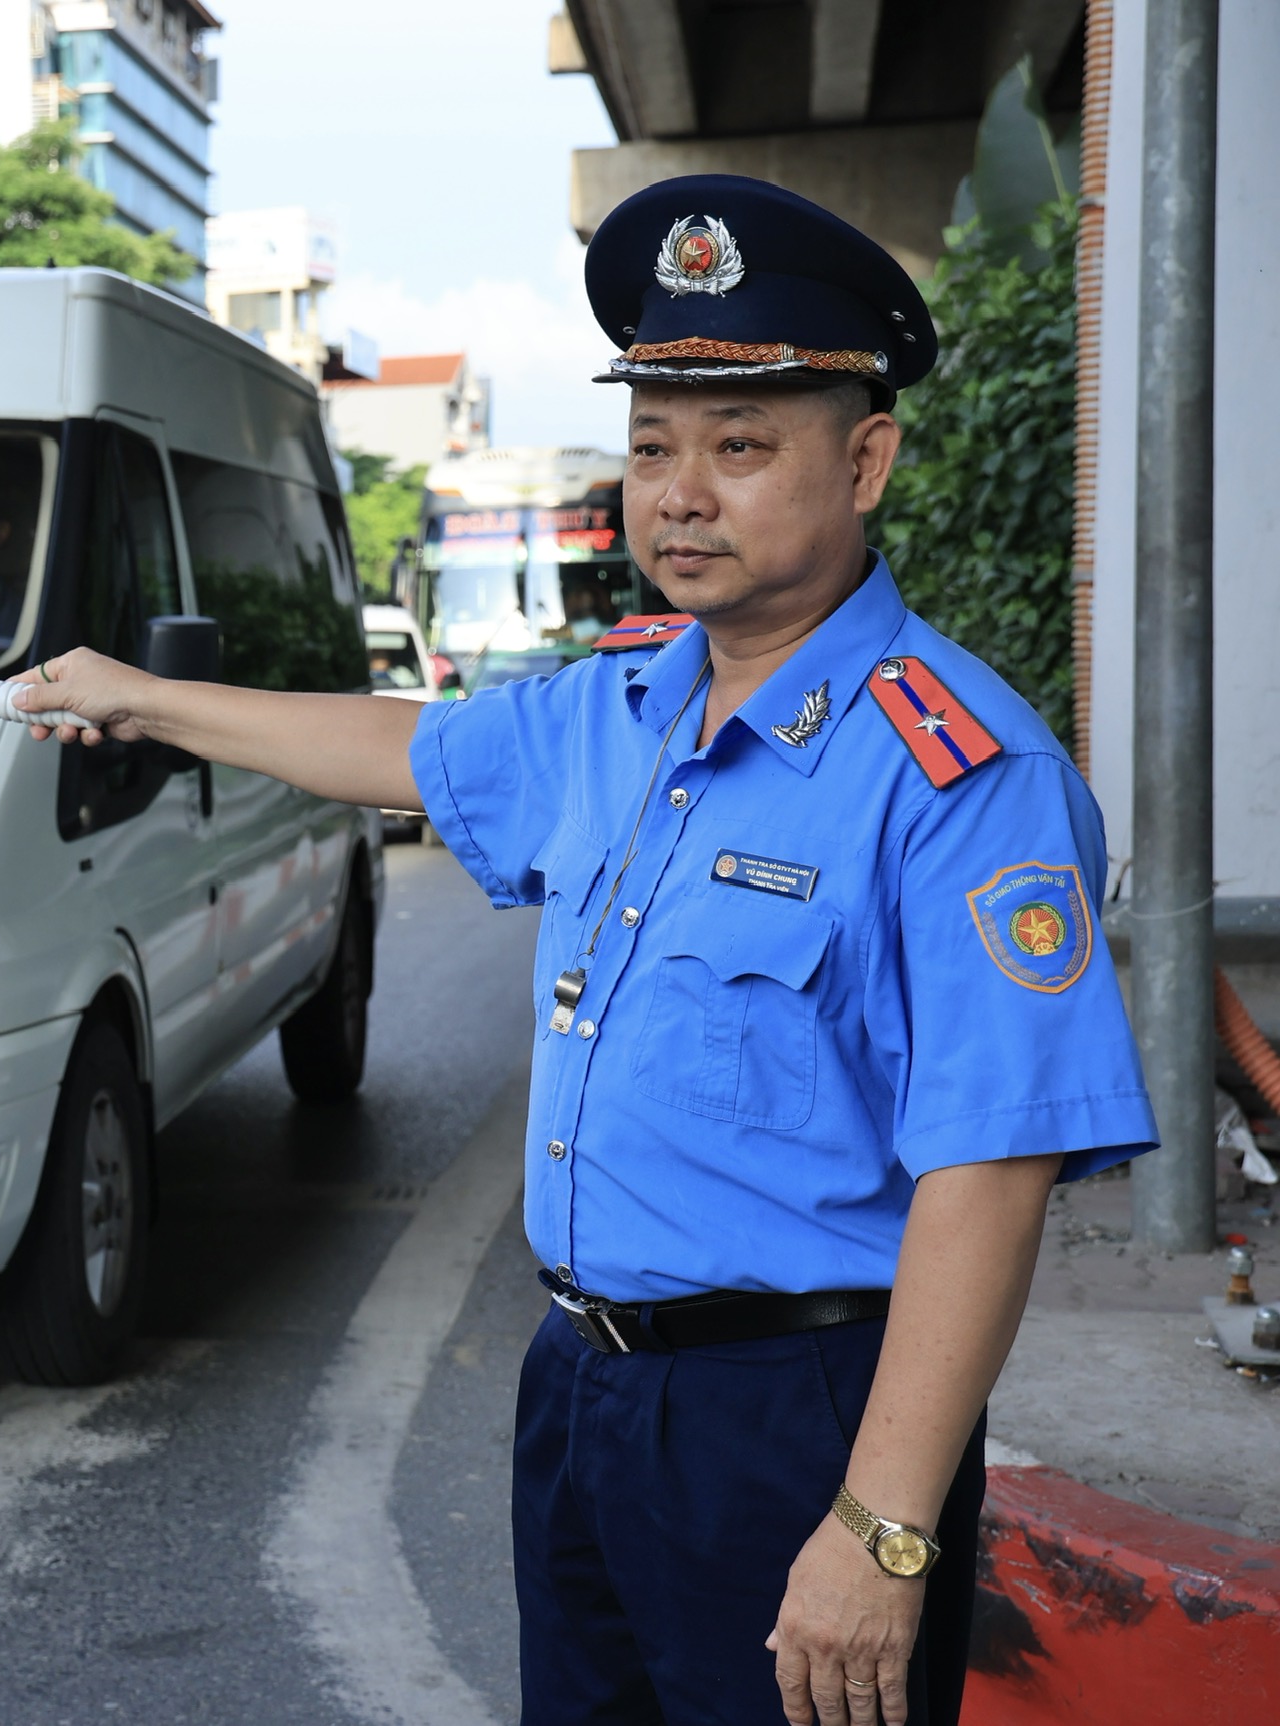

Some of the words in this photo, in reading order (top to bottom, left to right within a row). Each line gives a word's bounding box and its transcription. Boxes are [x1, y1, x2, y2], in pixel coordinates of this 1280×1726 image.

[740, 857, 758, 866] THANH
[777, 865, 791, 873] GTVT
[748, 878, 766, 888] THANH
[773, 874, 797, 885] CHUNG
[984, 894, 997, 907] SỞ
[994, 884, 1011, 898] GIAO
[1037, 873, 1053, 886] VẬN
[1054, 875, 1065, 888] TẢI
